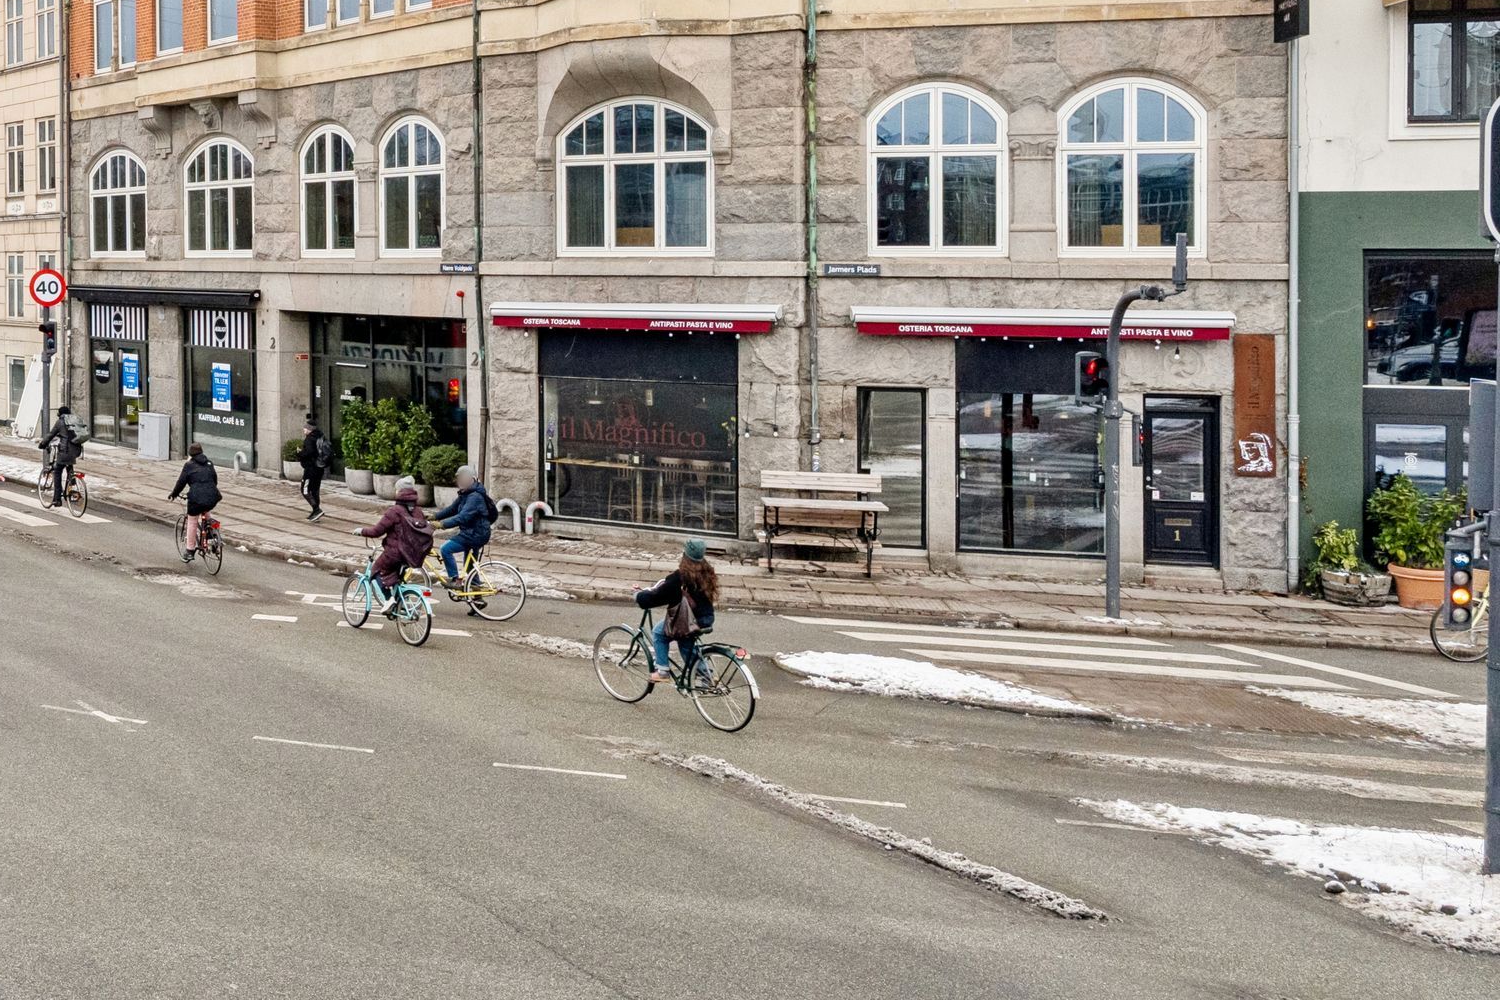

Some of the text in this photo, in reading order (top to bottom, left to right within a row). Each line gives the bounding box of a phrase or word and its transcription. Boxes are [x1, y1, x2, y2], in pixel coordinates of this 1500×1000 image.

[828, 265, 877, 273] Jarmers Plads
[36, 281, 59, 295] 40
[650, 320, 686, 328] ANTIPASTI
[686, 321, 708, 329] PASTA
[934, 325, 973, 333] TOSCANA
[1090, 328, 1134, 336] ANTSTI
[270, 337, 276, 349] 2
[471, 352, 479, 366] 2
[561, 416, 706, 448] il Magnifico
[1174, 529, 1180, 541] 1
